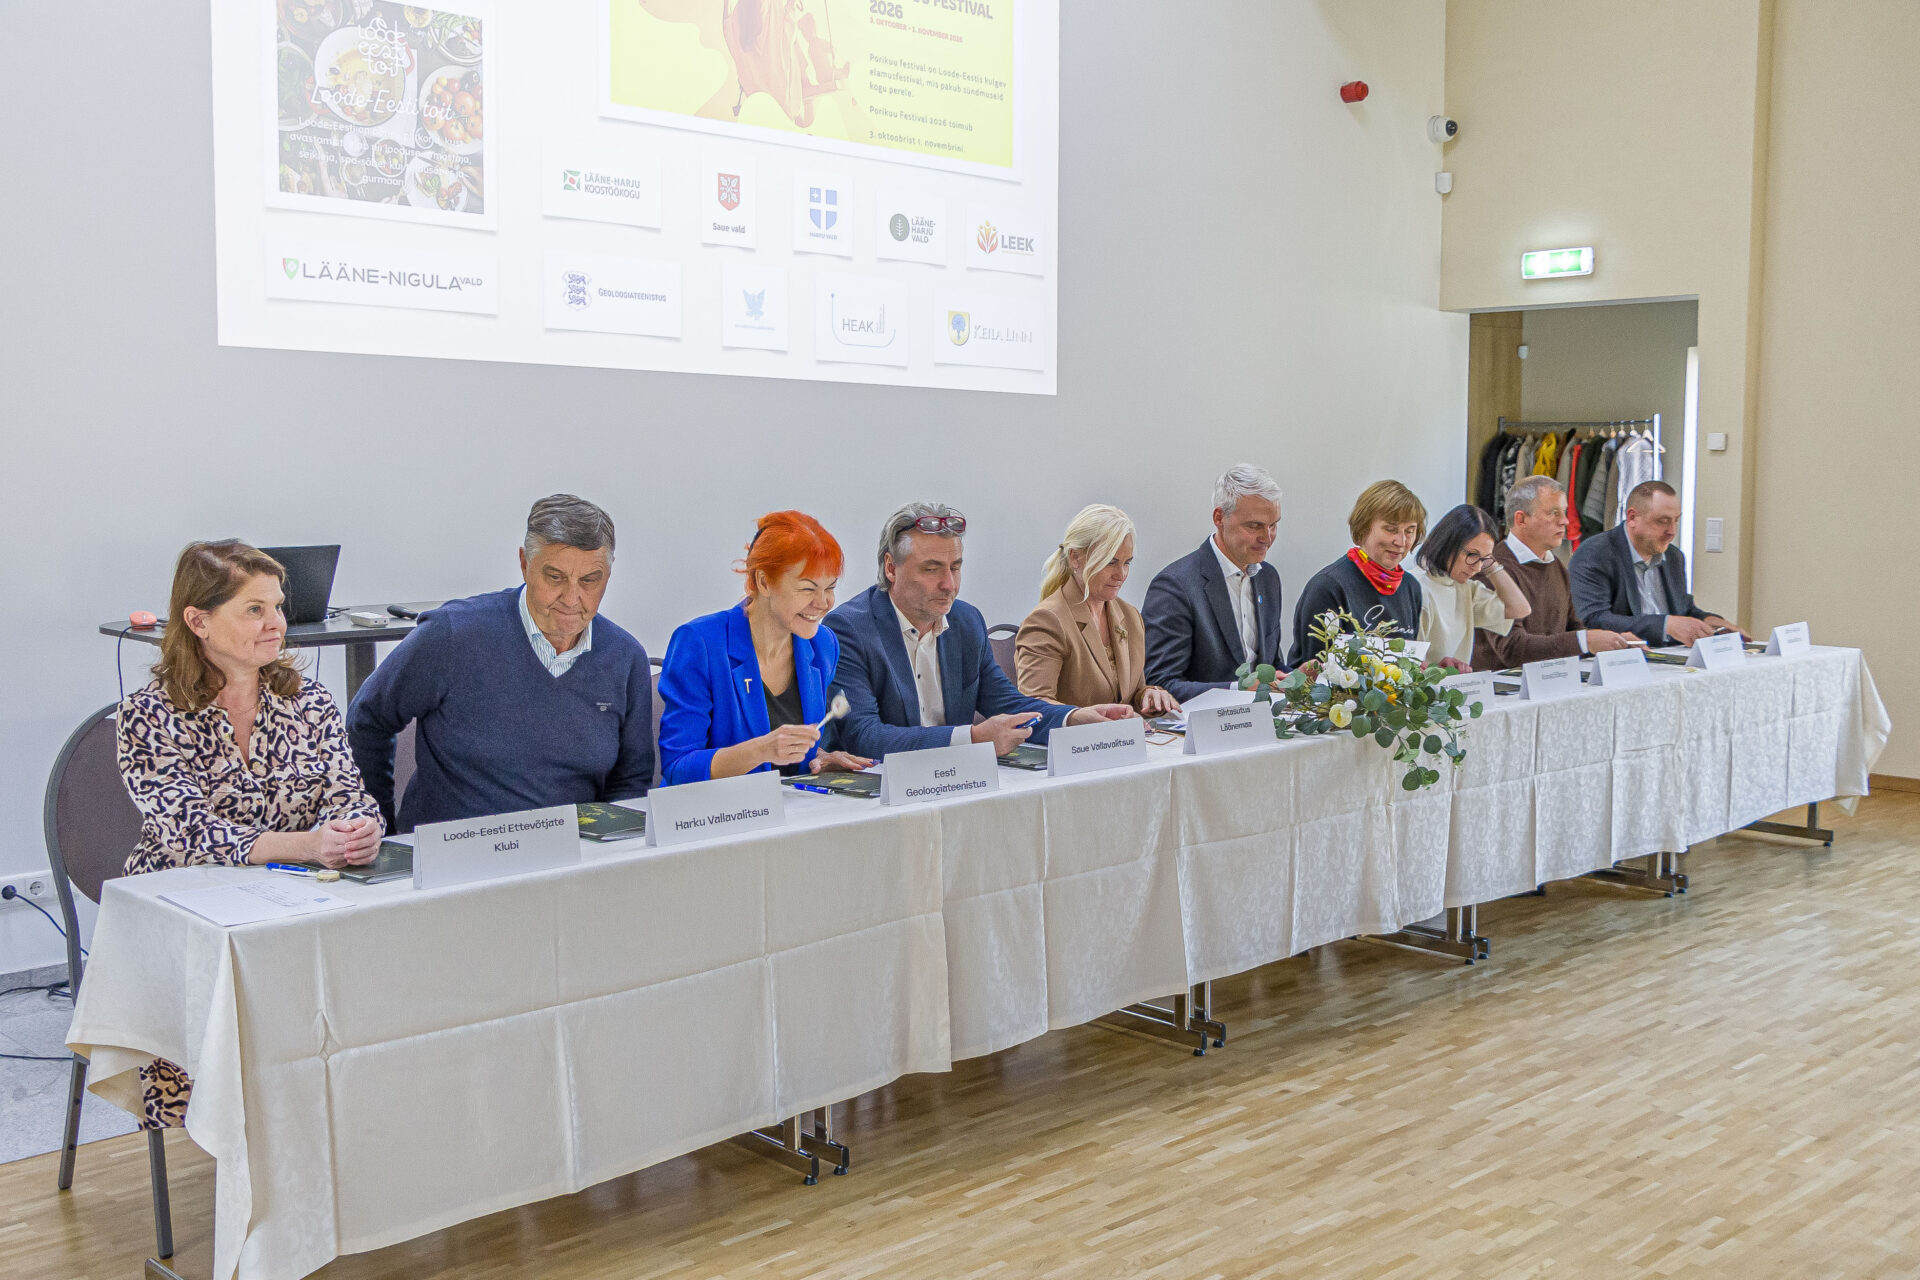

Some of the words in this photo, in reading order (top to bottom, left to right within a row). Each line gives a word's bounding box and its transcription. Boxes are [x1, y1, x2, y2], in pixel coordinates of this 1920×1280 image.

[869, 0, 904, 19] 2026
[869, 53, 898, 67] Porikuu
[899, 58, 927, 73] festival
[928, 66, 937, 74] on
[869, 81, 887, 94] kogu
[422, 101, 455, 122] toit
[869, 105, 898, 119] Porikuu
[899, 110, 928, 124] Festival
[929, 117, 947, 128] 2026
[583, 171, 641, 189] LÄÄNE-HARJU
[583, 183, 641, 200] KOOSTÖÖKOGU
[712, 221, 729, 233] Saue
[730, 223, 746, 234] vald
[911, 226, 934, 236] HARJU
[911, 234, 929, 244] VALD
[1001, 234, 1035, 252] LEEK
[302, 260, 462, 291] LÄÄNE-NIGULA
[461, 276, 484, 287] VALD
[841, 318, 874, 334] HEAK
[1071, 745, 1090, 754] Saue
[1091, 738, 1135, 751] Vallavalitsus
[934, 766, 957, 779] Eesti
[905, 780, 987, 797] Geoloogiateenistus
[675, 817, 706, 831] Harku
[707, 807, 770, 825] Vallavalitsus
[443, 823, 507, 842] Loode-Eesti
[508, 817, 565, 833] Ettevõtjate
[494, 839, 520, 852] Klubi
